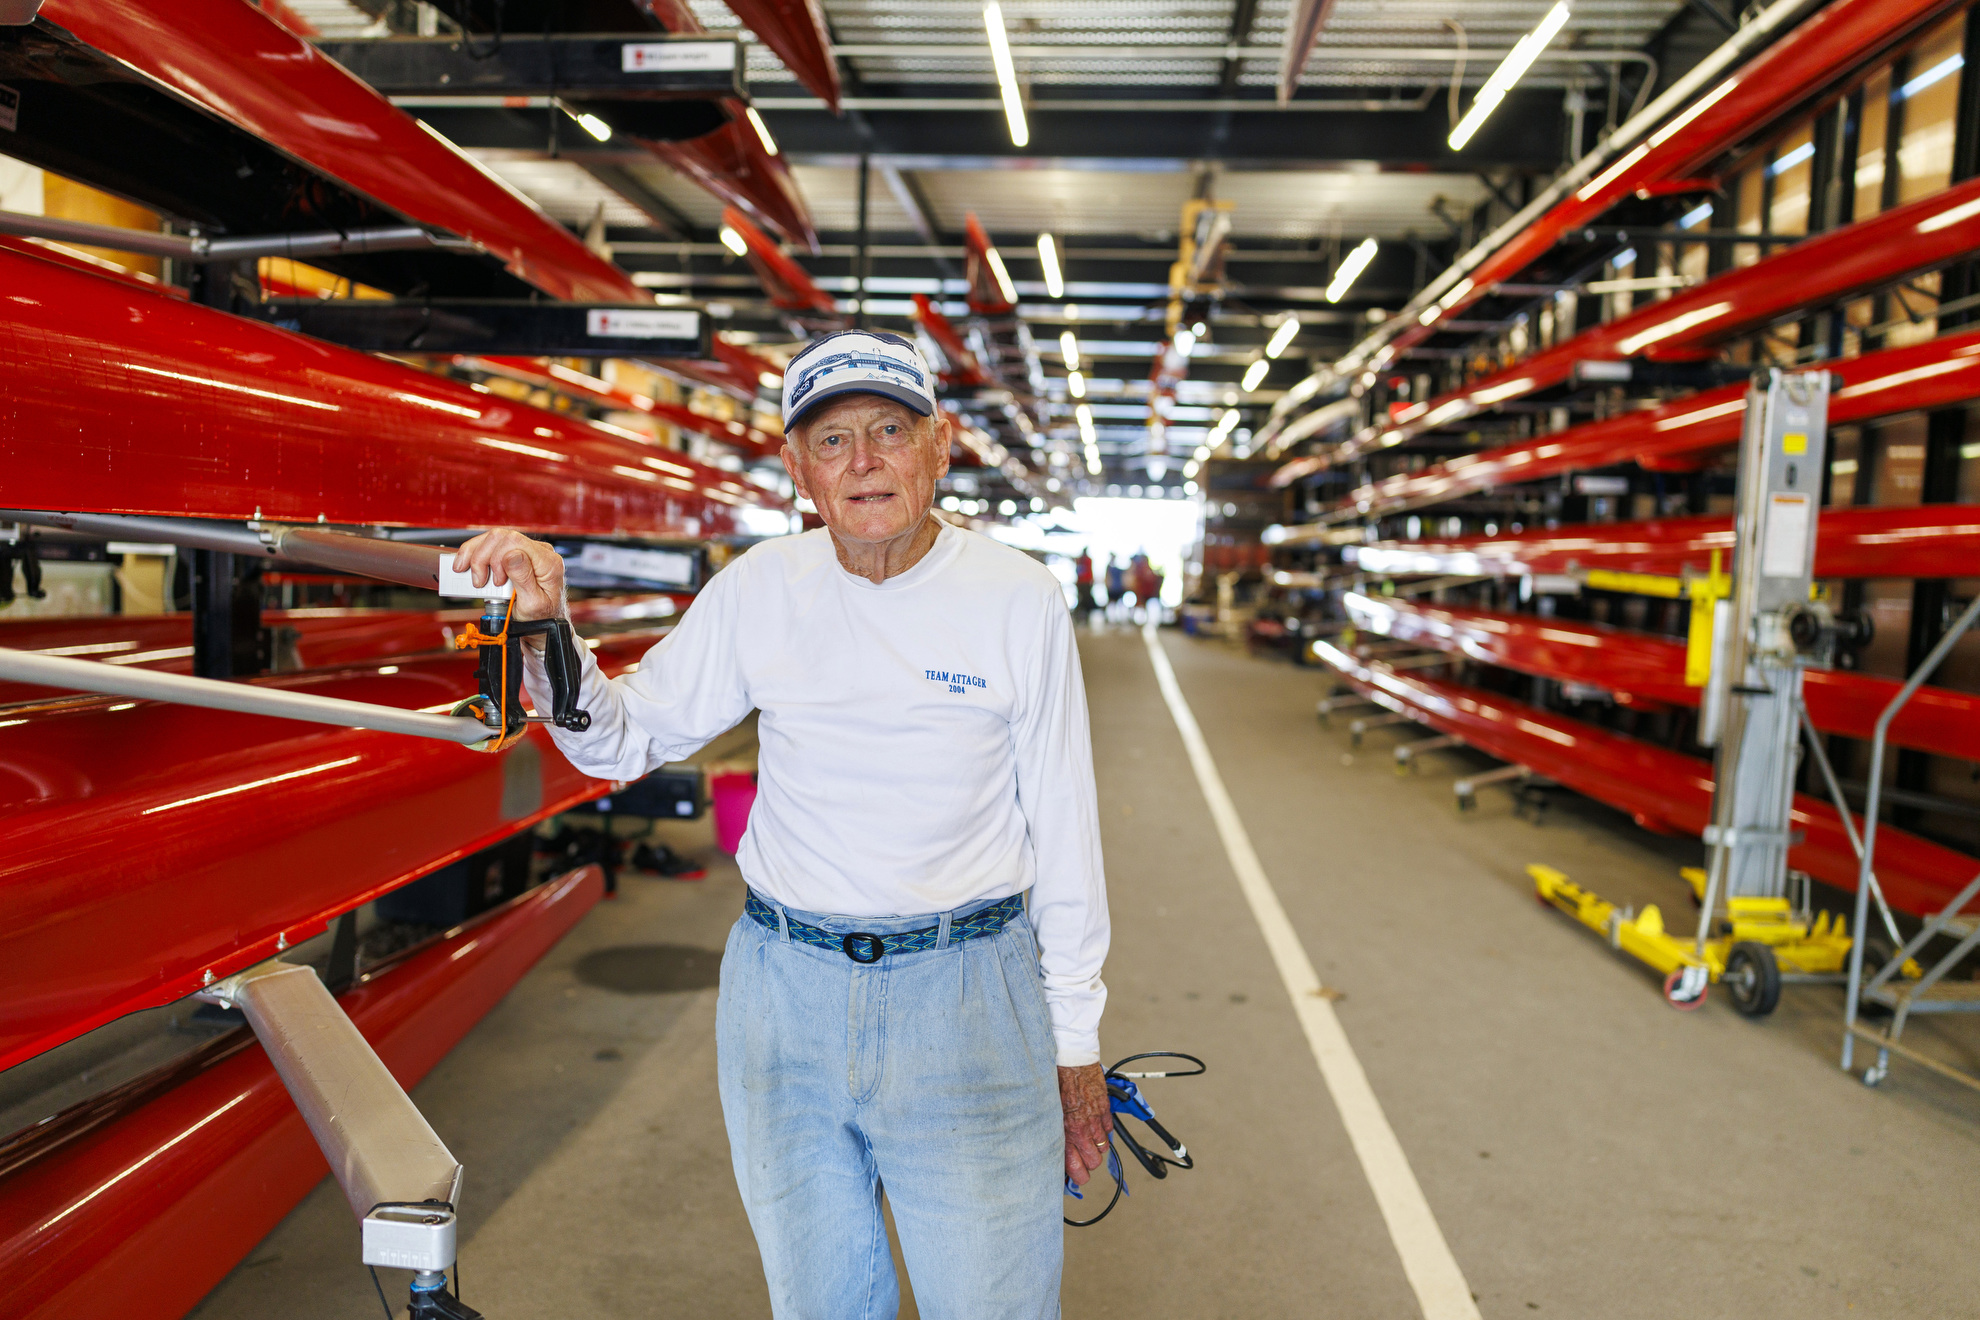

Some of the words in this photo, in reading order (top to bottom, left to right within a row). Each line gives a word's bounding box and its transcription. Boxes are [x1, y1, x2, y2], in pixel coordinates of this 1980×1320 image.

[925, 670, 949, 682] TEAM
[951, 673, 987, 688] ATTAGER
[949, 684, 965, 694] 2004
